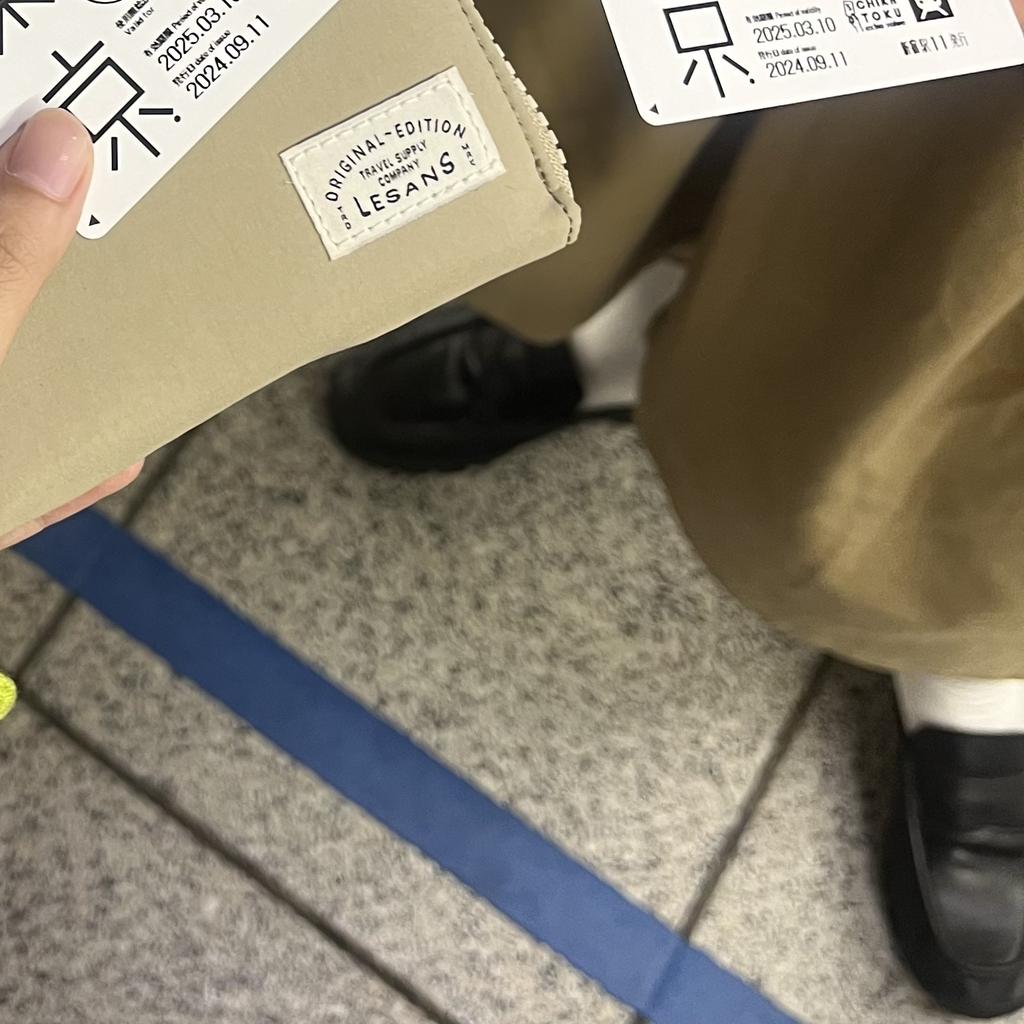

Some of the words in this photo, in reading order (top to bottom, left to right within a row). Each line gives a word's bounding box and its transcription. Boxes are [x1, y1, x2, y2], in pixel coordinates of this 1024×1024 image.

[752, 16, 838, 45] 2025.03.10
[860, 7, 903, 24] TOKU
[185, 14, 270, 100] 2024.09.11
[764, 50, 849, 79] 2024.09.11
[358, 158, 395, 181] TRAVEL
[394, 138, 428, 165] SUPPLY
[377, 158, 420, 188] COMPANY
[351, 150, 456, 220] LESANS
